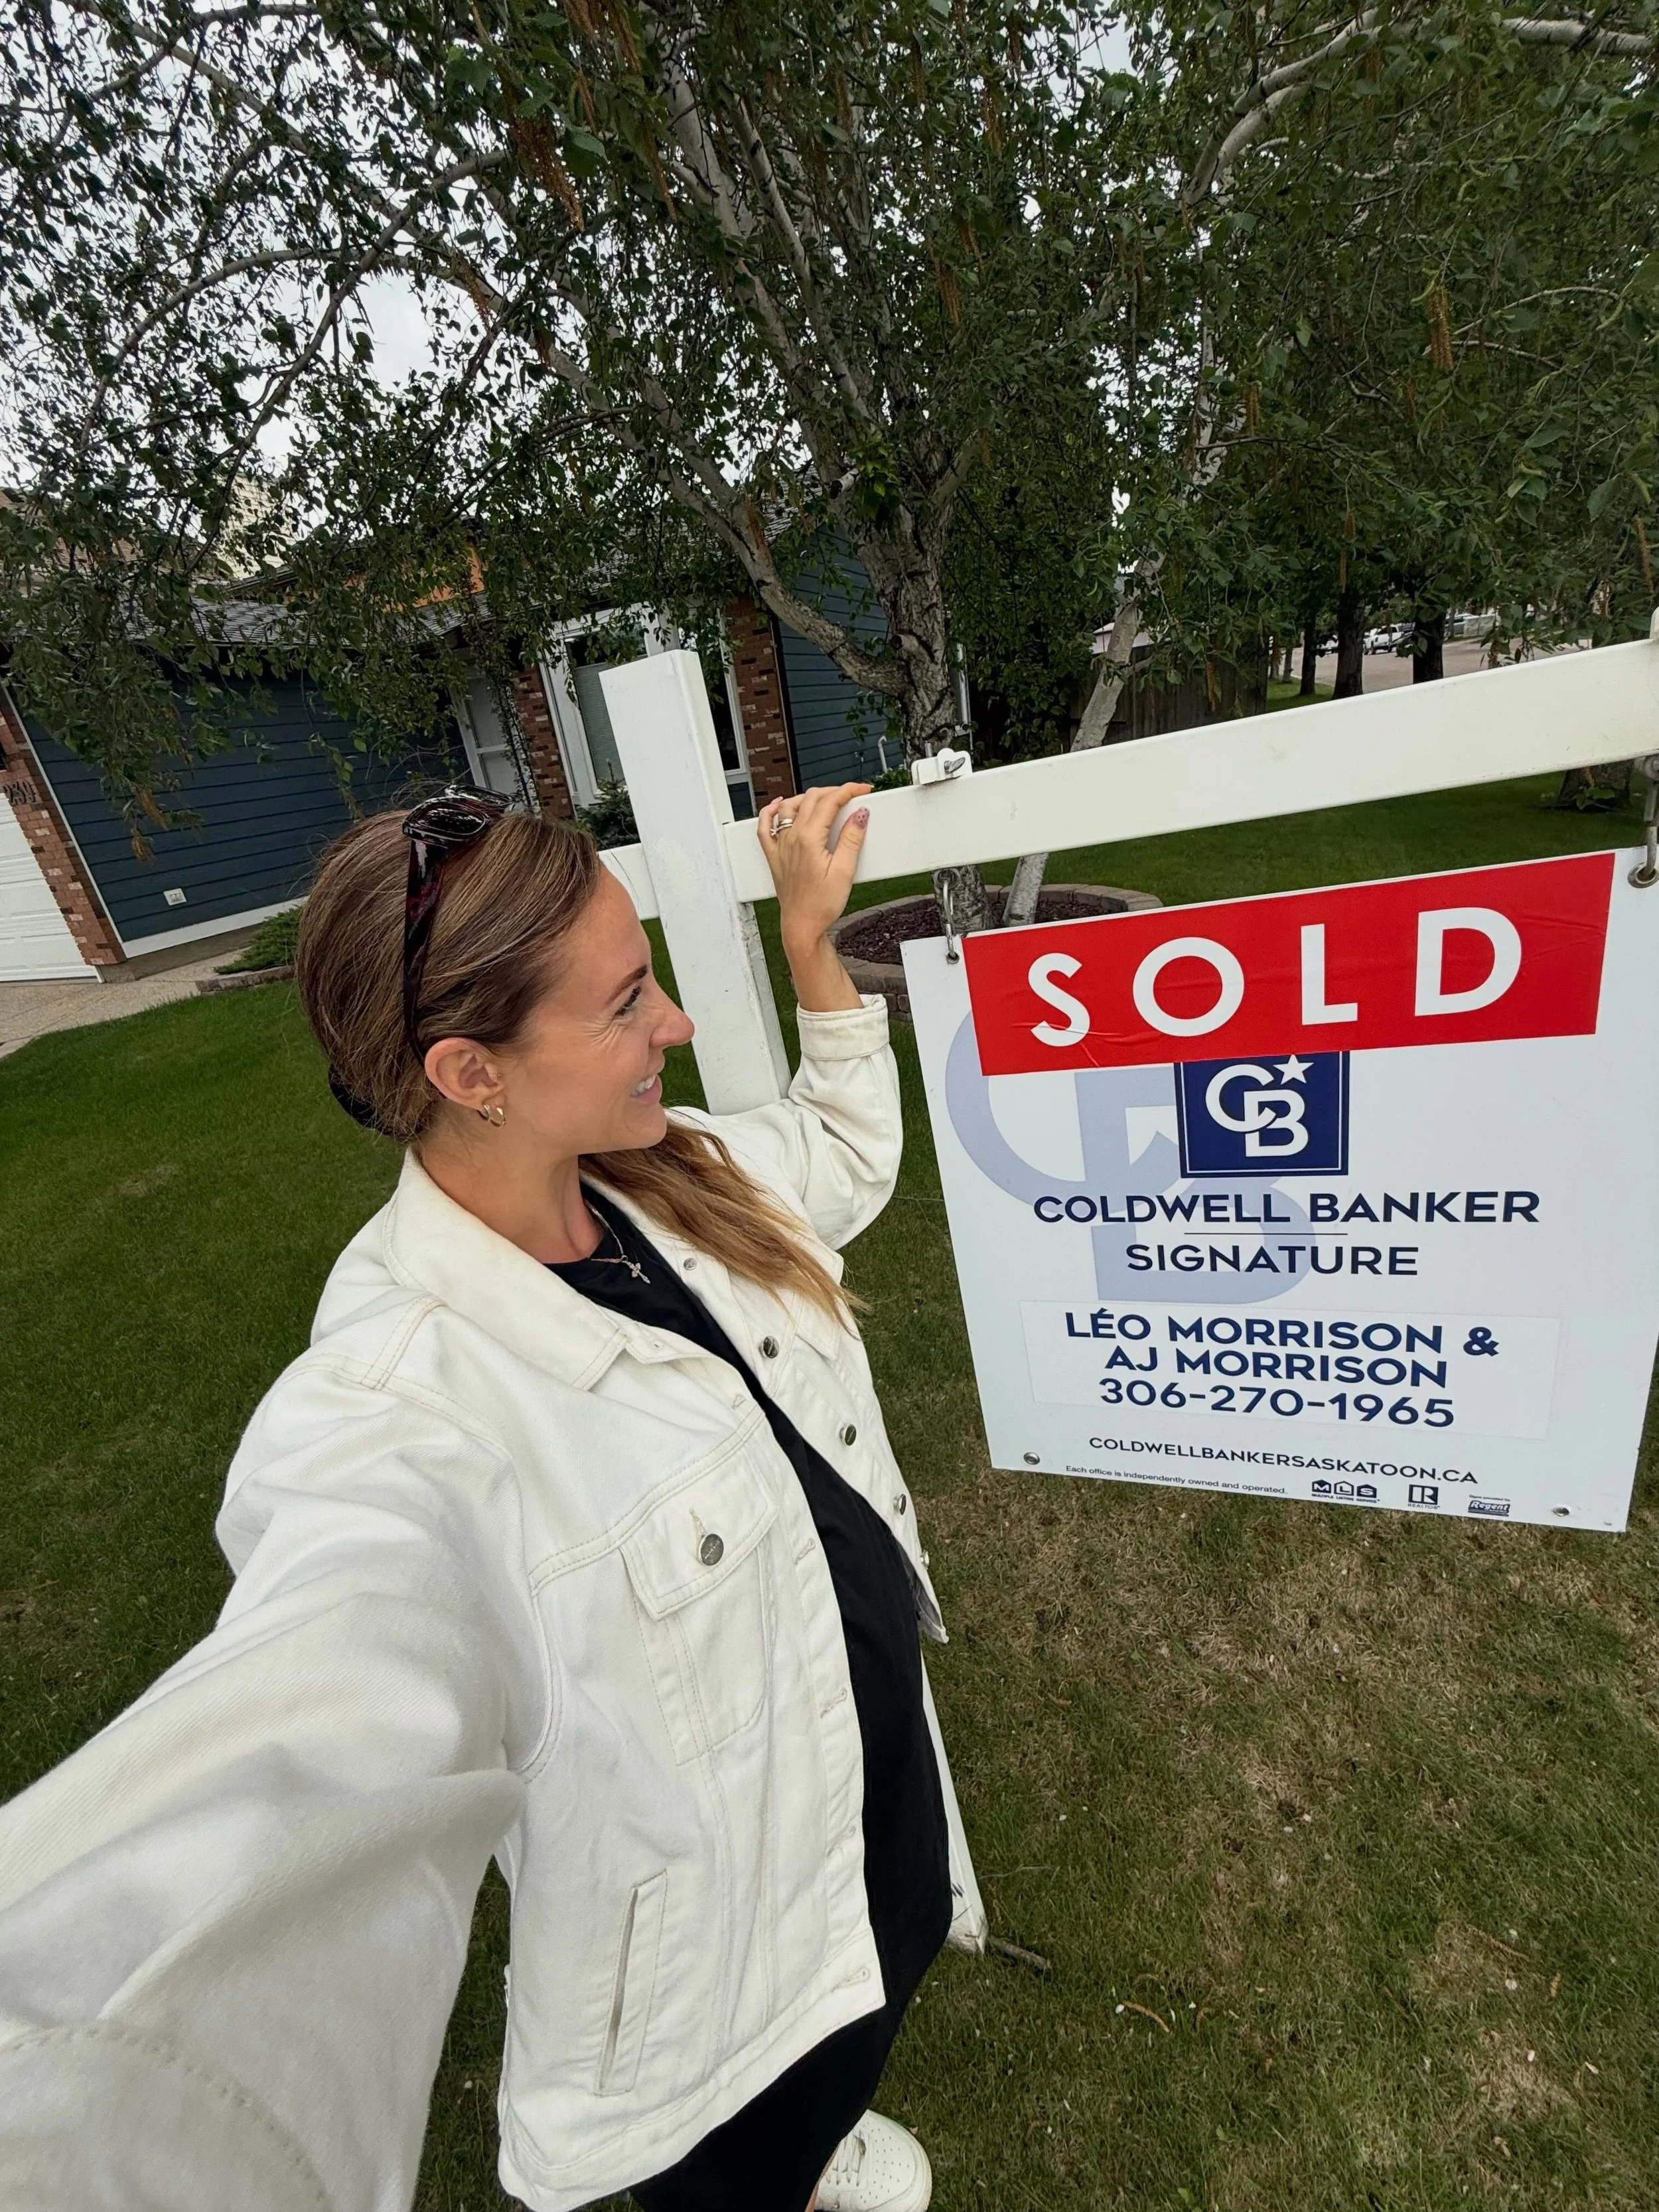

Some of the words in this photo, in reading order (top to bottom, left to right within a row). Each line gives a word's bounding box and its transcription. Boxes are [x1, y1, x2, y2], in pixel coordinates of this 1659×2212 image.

[1028, 907, 1522, 1047] SOLD
[1033, 1193, 1291, 1223] COLDWELL
[1309, 1191, 1540, 1222] BANKER
[1125, 1244, 1419, 1276] SIGNATURE
[1065, 1307, 1151, 1341] LÉO
[1168, 1315, 1443, 1354] MORRISON
[1463, 1327, 1500, 1357] &
[1104, 1345, 1158, 1372] AJ
[1175, 1348, 1447, 1389] MORRISON
[1099, 1378, 1454, 1428] 306-270-1965
[1066, 1465, 1087, 1473] Each
[1123, 1471, 1186, 1484] independently
[1188, 1478, 1219, 1487] owned
[1089, 1438, 1479, 1484] COLDWELLBANKERSASKATOON.CA
[1313, 1481, 1376, 1497] MLS
[1470, 1501, 1509, 1511] Regent
